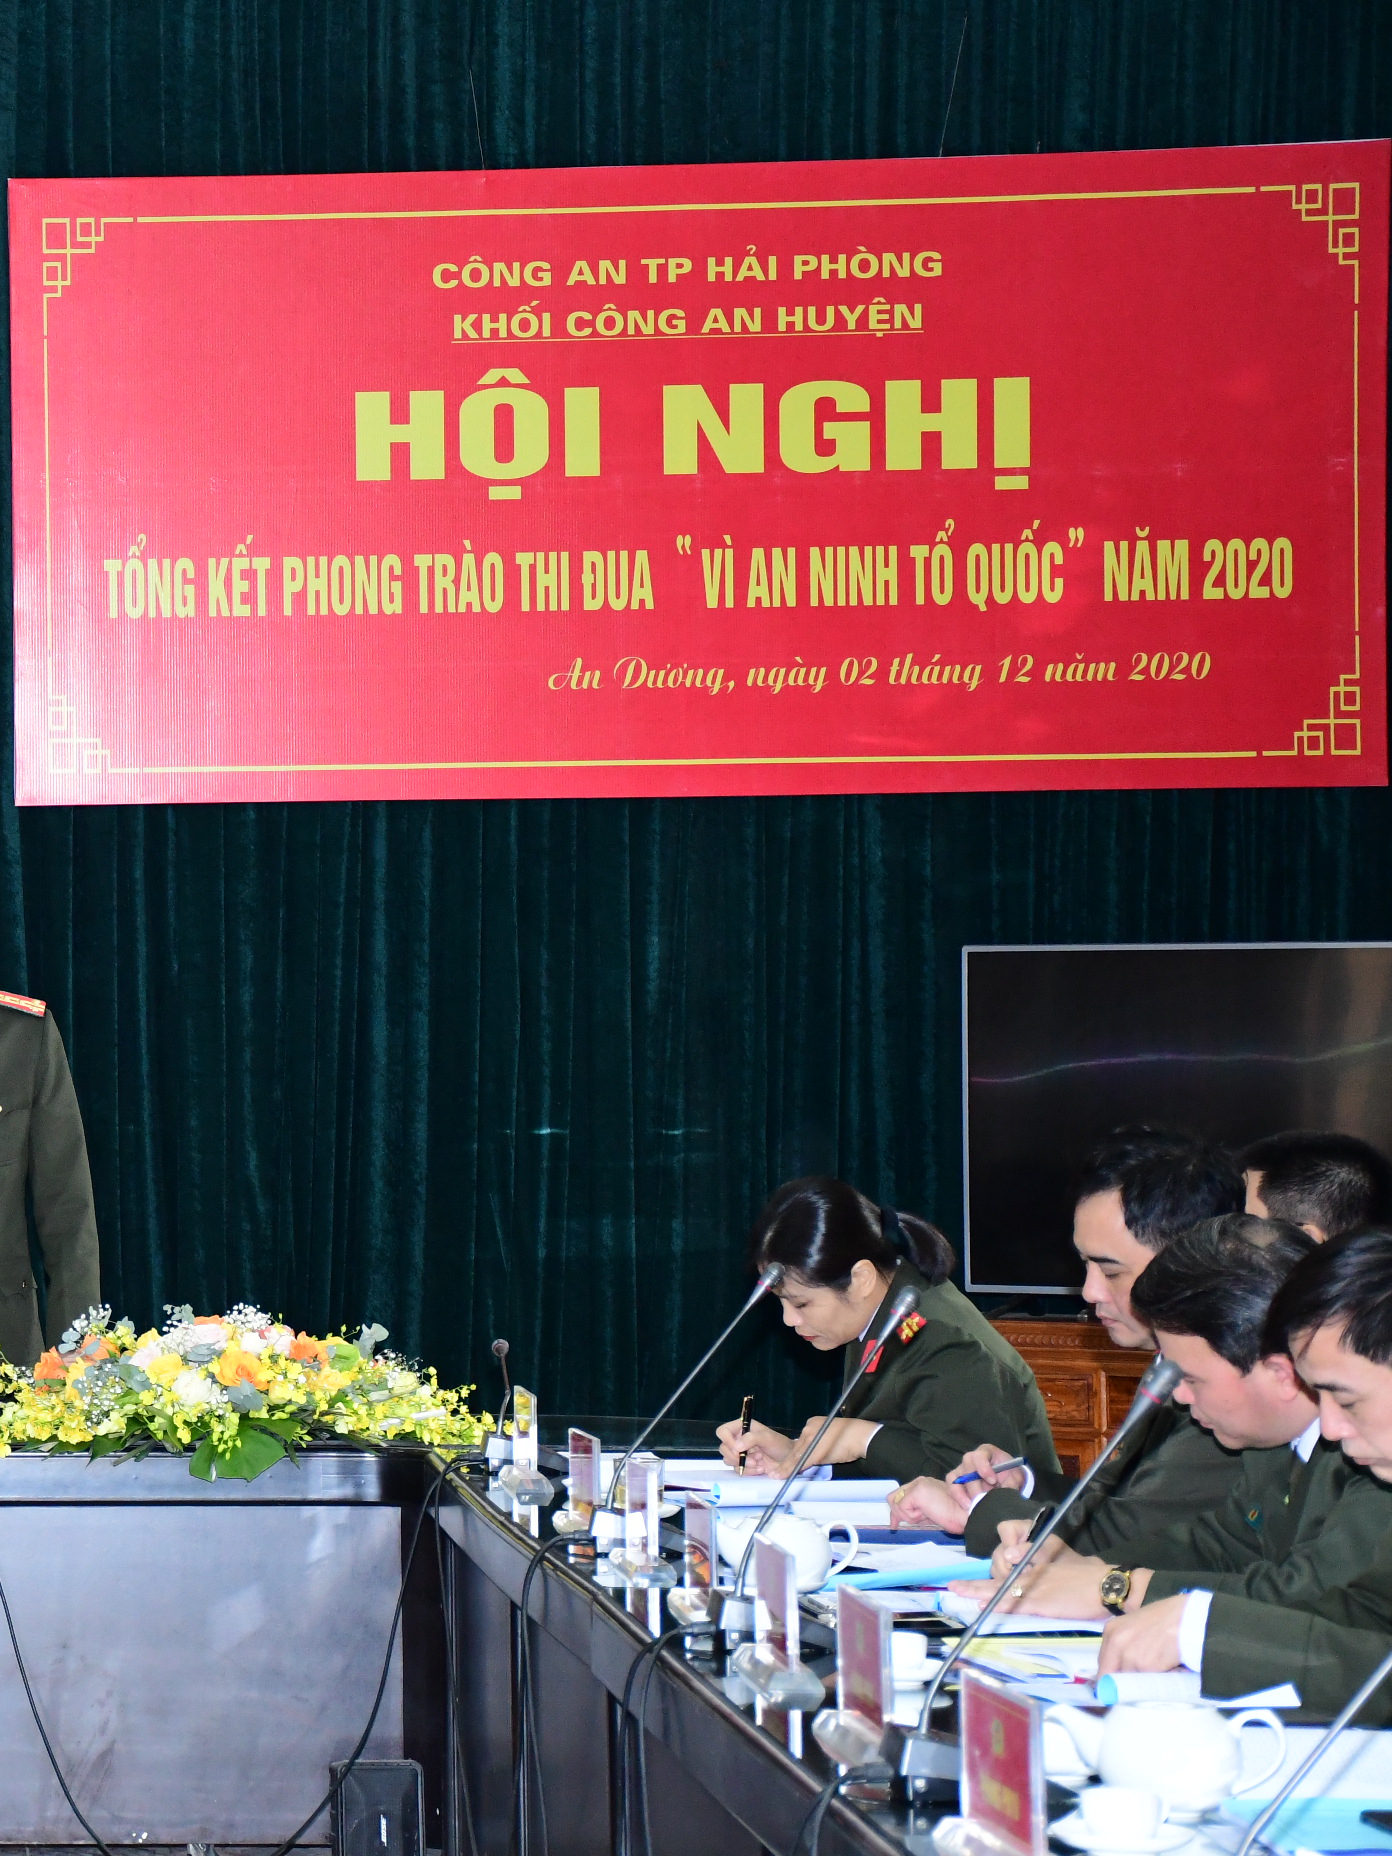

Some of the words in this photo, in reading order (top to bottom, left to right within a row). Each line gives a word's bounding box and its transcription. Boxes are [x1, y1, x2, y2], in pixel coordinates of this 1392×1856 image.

[432, 255, 552, 289] CÔNG
[565, 259, 627, 286] AN
[640, 257, 693, 284] TP
[707, 244, 777, 282] HẢI
[793, 245, 943, 281] PHÒNG
[453, 301, 551, 340] KHỐI
[566, 304, 687, 337] CÔNG
[700, 307, 762, 334] AN
[777, 296, 923, 338] HUYỆN
[354, 367, 601, 501] HỘI
[662, 376, 1031, 491] NGHỊ
[103, 533, 195, 619] TỔNG
[207, 534, 271, 617] KẾT
[282, 554, 403, 616] PHONG
[413, 539, 505, 614] TRÀO
[514, 550, 570, 612] THI
[581, 549, 655, 612] ĐUA
[746, 546, 797, 608] AN
[809, 545, 898, 607] NINH
[909, 518, 955, 606] TỔ
[966, 519, 1085, 612] QUỐC”
[1103, 526, 1190, 602] NĂM
[1202, 536, 1293, 600] 2020
[547, 656, 605, 691] An
[613, 656, 735, 695] Dương,
[746, 656, 829, 694] ngày
[839, 656, 878, 686] 02
[888, 652, 985, 693] tháng
[998, 654, 1034, 683] 12
[1044, 652, 1118, 682] năm
[1128, 651, 1211, 681] 2020
